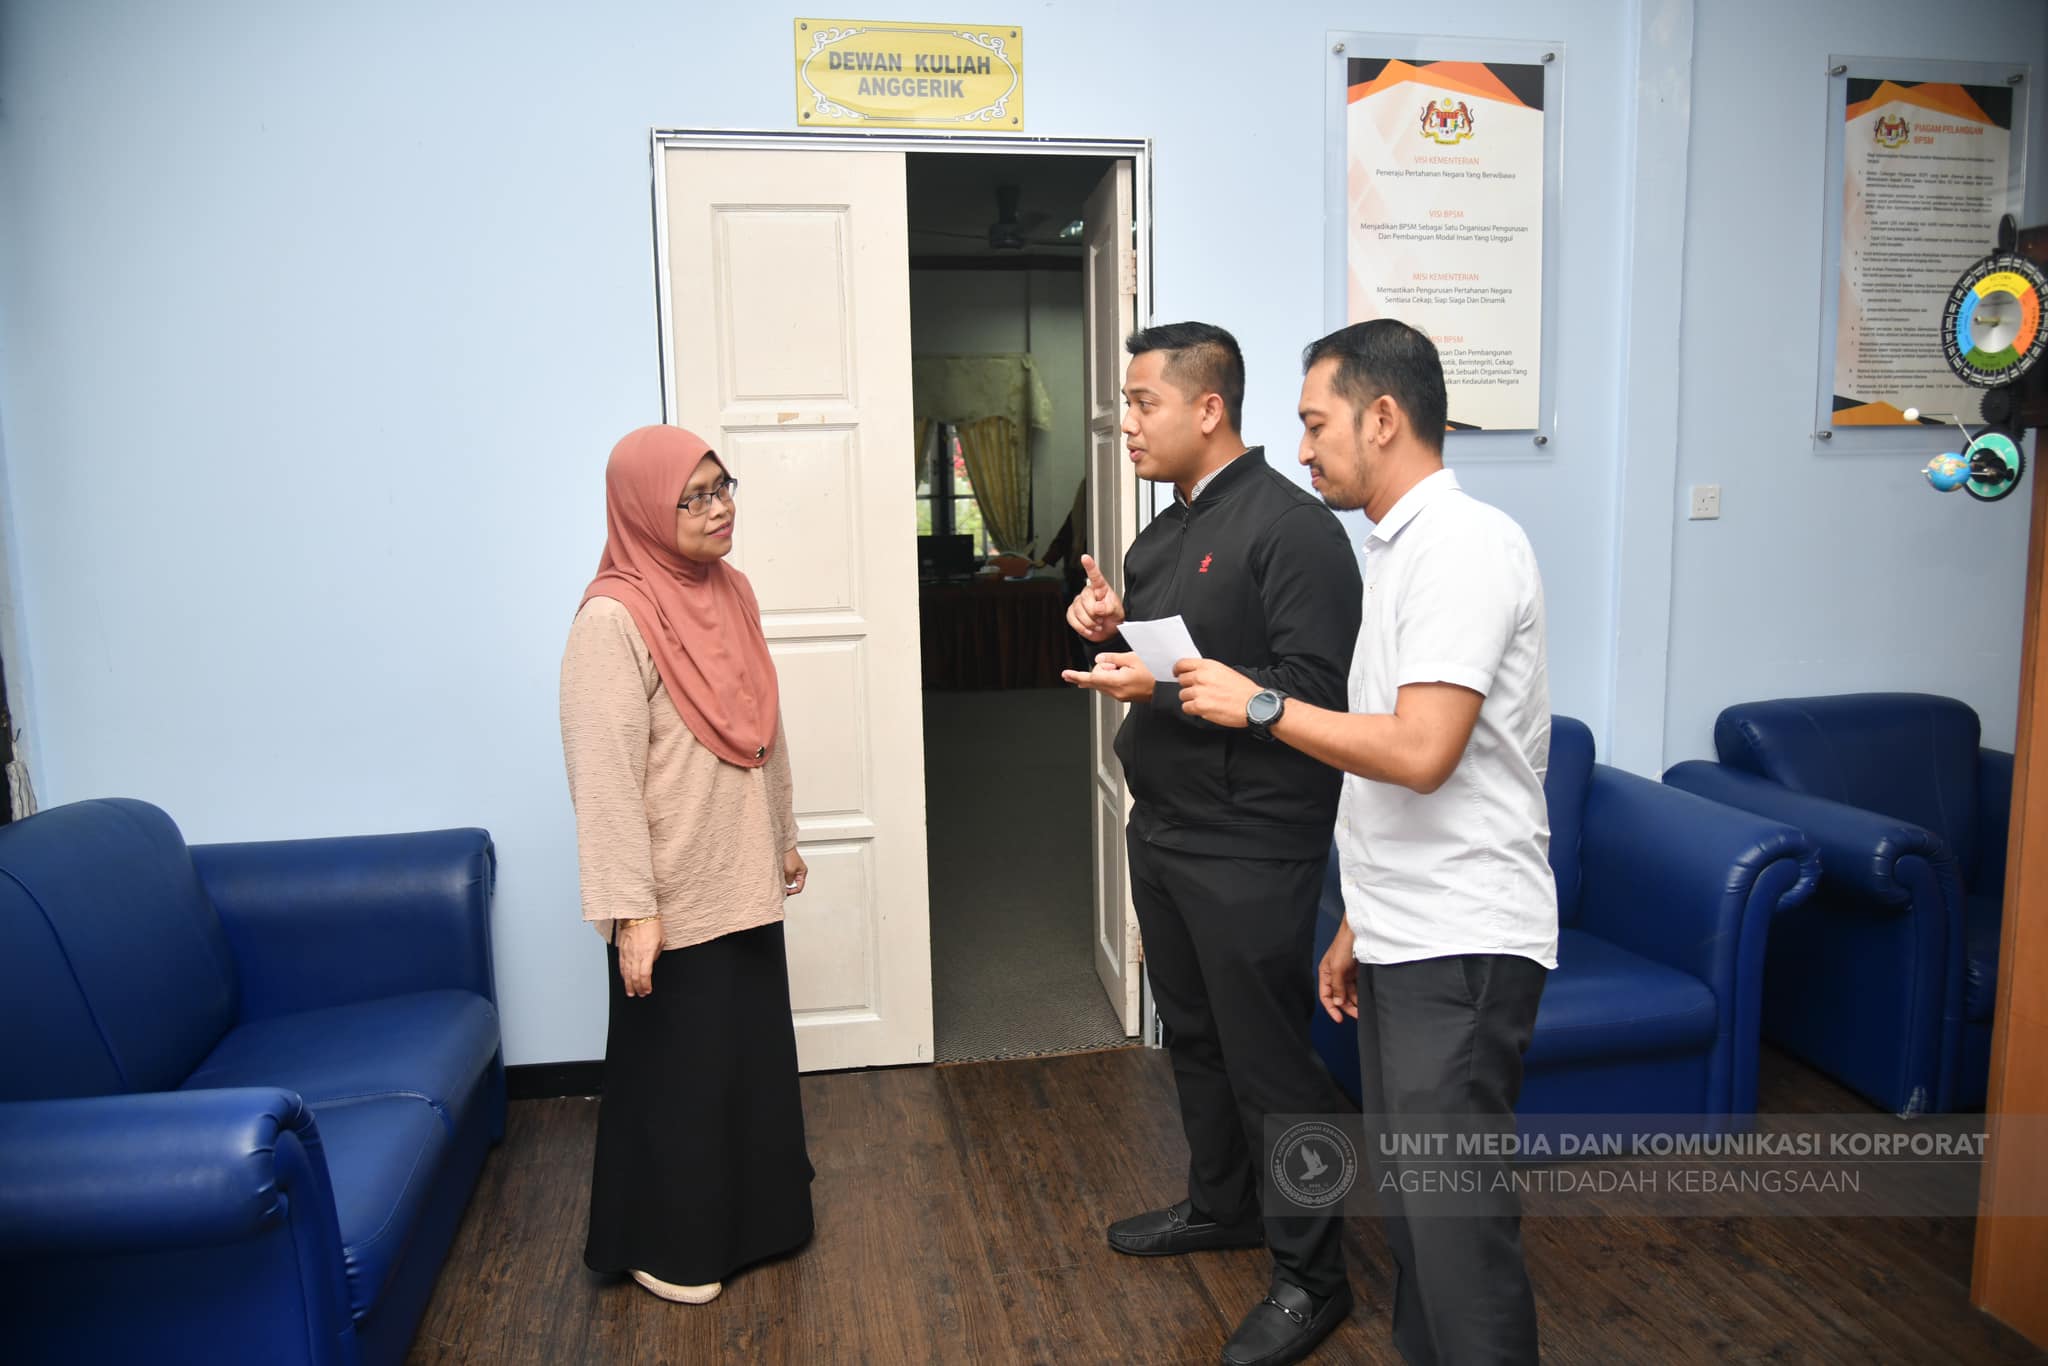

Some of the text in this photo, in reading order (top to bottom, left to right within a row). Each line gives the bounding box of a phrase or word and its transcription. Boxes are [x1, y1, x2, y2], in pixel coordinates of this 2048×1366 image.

[829, 51, 990, 74] DEWAN KULIAH
[858, 77, 964, 98] ANGGERIK
[1430, 156, 1479, 166] KEMENTERIAN
[1376, 168, 1404, 178] Peneraju
[1405, 169, 1440, 178] Pertahanan
[1442, 170, 1464, 180] Negara
[1466, 171, 1480, 180] Yang
[1444, 210, 1464, 219] BPSM
[1361, 222, 1528, 233] Menjadikan BPSM Sebagai Satu Organisasi Pengurusan
[1378, 233, 1391, 241] Dan
[1435, 233, 1455, 242] Modal
[1474, 233, 1489, 243] Yang
[1490, 234, 1513, 244] Unggul
[1429, 273, 1479, 281] KEMENTERIAN
[1416, 286, 1452, 295] Pengurusan
[1454, 287, 1489, 295] Pertahanan
[1491, 287, 1512, 296] Negara
[1449, 297, 1465, 305] Siaga
[1468, 349, 1512, 357] Pembangunan
[1498, 378, 1519, 386] Negara
